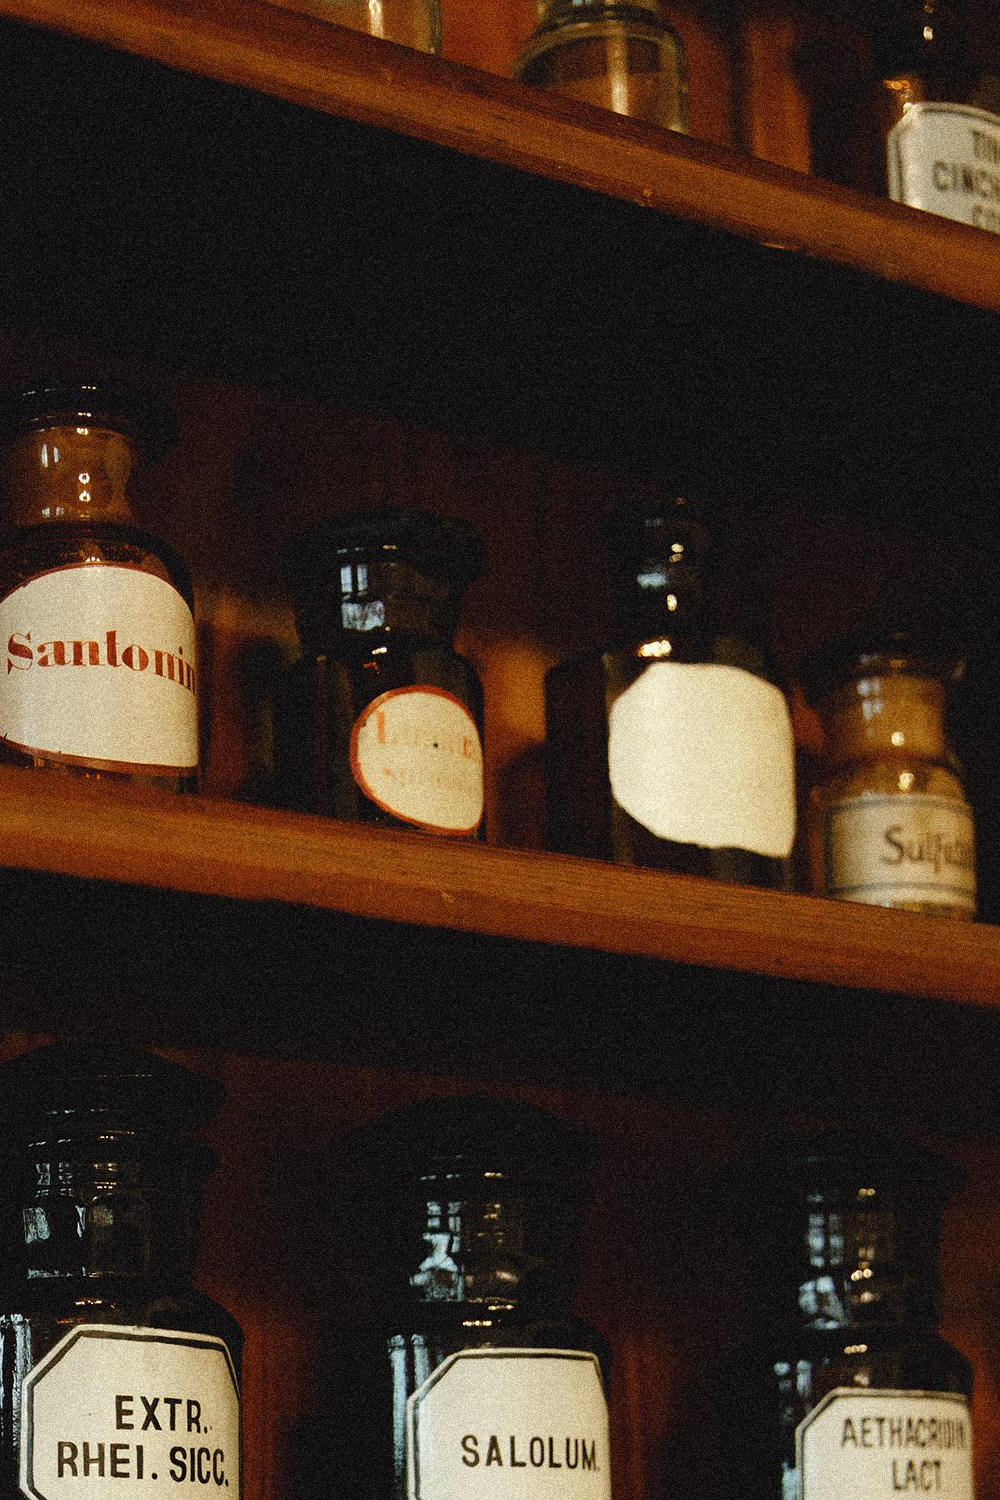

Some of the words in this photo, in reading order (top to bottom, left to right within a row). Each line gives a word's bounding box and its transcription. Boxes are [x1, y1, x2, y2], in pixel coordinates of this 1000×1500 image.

[114, 1395, 210, 1435] EXTR.
[56, 1441, 157, 1481] RHEI.
[169, 1446, 231, 1489] SICC.
[460, 1434, 602, 1472] SALOLUM.
